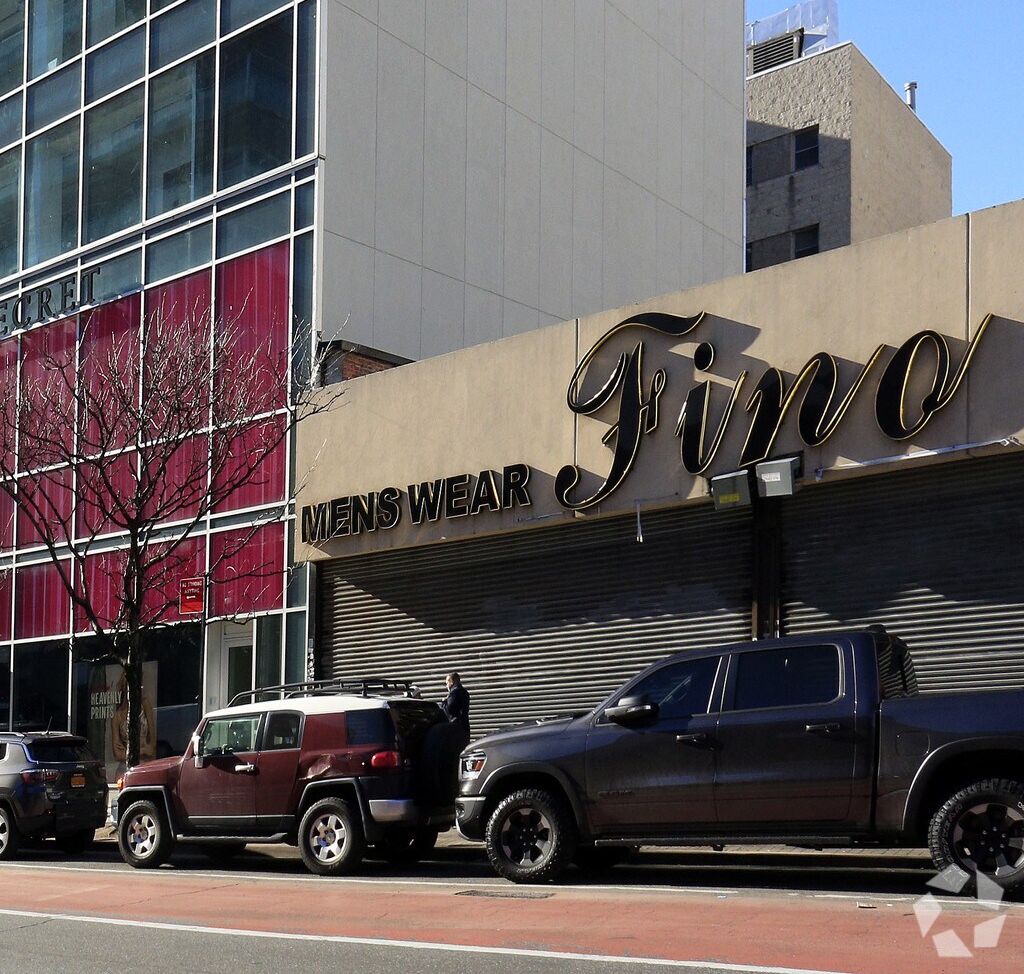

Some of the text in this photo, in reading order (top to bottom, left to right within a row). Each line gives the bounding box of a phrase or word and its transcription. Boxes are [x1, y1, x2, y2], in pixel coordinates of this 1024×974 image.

[554, 311, 993, 510] Fino
[301, 463, 531, 543] MENS WEAR
[90, 690, 122, 706] HEAVENLY
[90, 706, 115, 720] PRINTS
